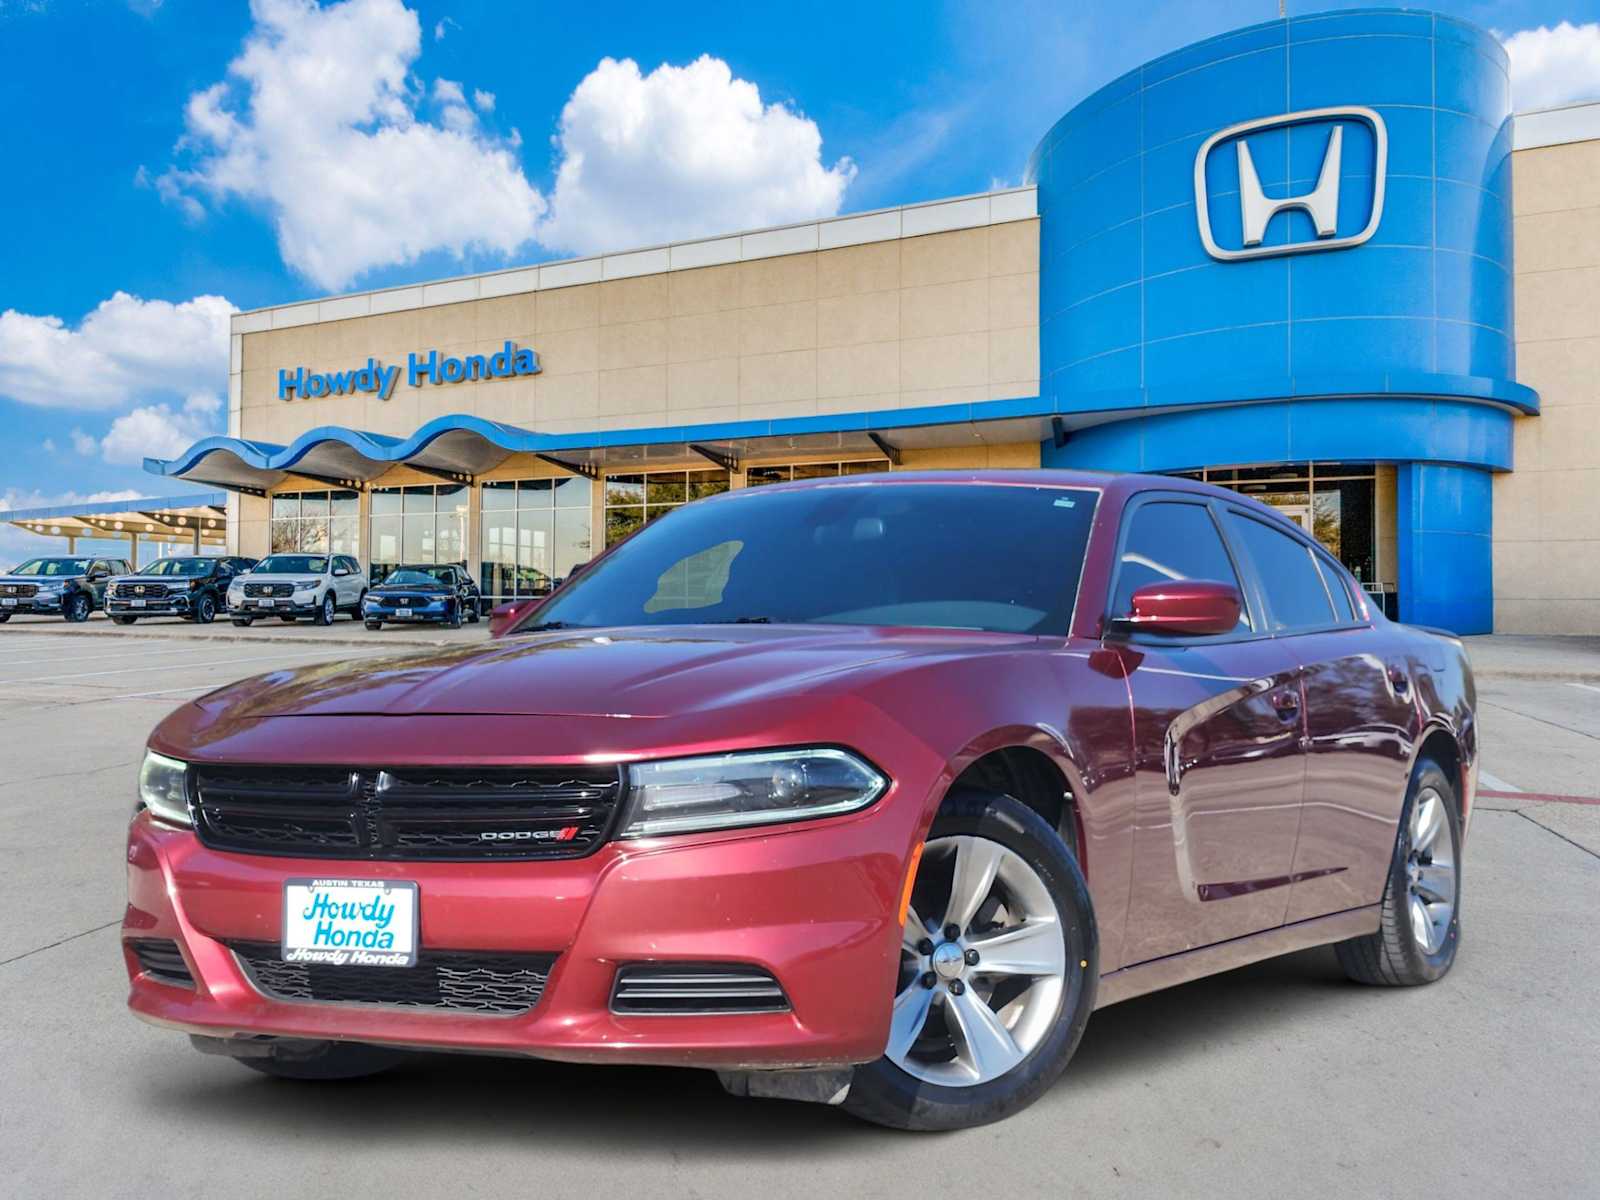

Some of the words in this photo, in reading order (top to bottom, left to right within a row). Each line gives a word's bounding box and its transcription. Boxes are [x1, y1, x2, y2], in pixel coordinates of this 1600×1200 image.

[278, 358, 401, 400] Howdy
[408, 340, 542, 387] Honda
[480, 830, 562, 840] DODGE
[312, 879, 348, 888] AUSTIN
[351, 880, 385, 888] TEXAS
[303, 893, 395, 929] Howdy
[313, 920, 394, 949] Honda
[286, 948, 349, 965] Howdy
[350, 951, 409, 965] Honda
